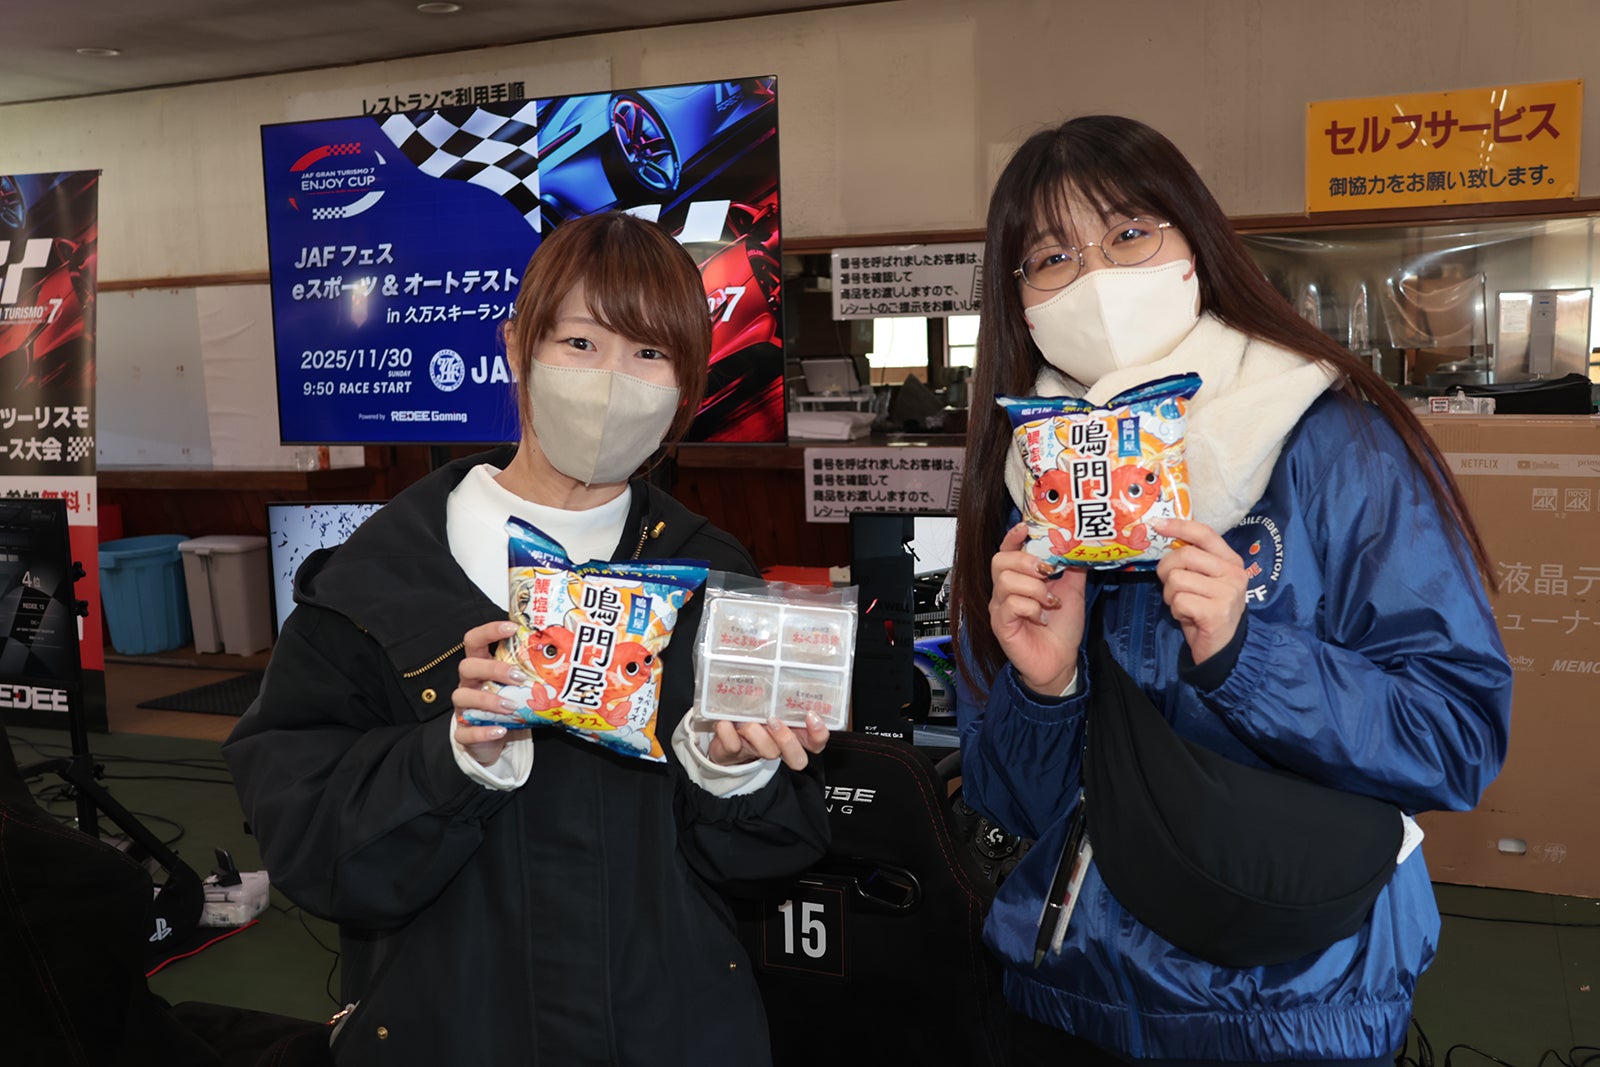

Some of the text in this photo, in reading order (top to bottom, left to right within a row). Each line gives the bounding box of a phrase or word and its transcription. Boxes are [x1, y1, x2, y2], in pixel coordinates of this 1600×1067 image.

[362, 81, 525, 115] レストランご利用手順
[1325, 103, 1560, 155] セルフサービス
[301, 171, 314, 179] JAF
[314, 169, 336, 178] GRAN
[337, 168, 369, 176] TURISMO
[301, 176, 376, 191] ENJOY CUP
[1329, 164, 1555, 198] 御協力をお願い致します。
[292, 268, 519, 300] eスポーツ & オートテスト
[840, 271, 913, 285] 番号を確認して
[4, 298, 63, 324] TURISMO 7
[387, 308, 400, 324] in
[721, 286, 746, 323] 7
[301, 348, 413, 371] 2025/11/30
[471, 355, 518, 384] JA
[388, 370, 411, 378] SUNDAY
[303, 381, 413, 395] 9:50 RACE START
[391, 411, 430, 422] REDEE
[431, 411, 468, 423] Gaming
[1460, 458, 1499, 469] NETFLIX
[813, 474, 889, 486] 番号を確認して
[1071, 419, 1114, 539] 鳴門屋
[1261, 517, 1284, 581] FEDERATION
[1245, 584, 1268, 604] FF
[1494, 608, 1600, 635] ューナ
[560, 586, 622, 707] 鳴門屋
[777, 899, 827, 959] 15
